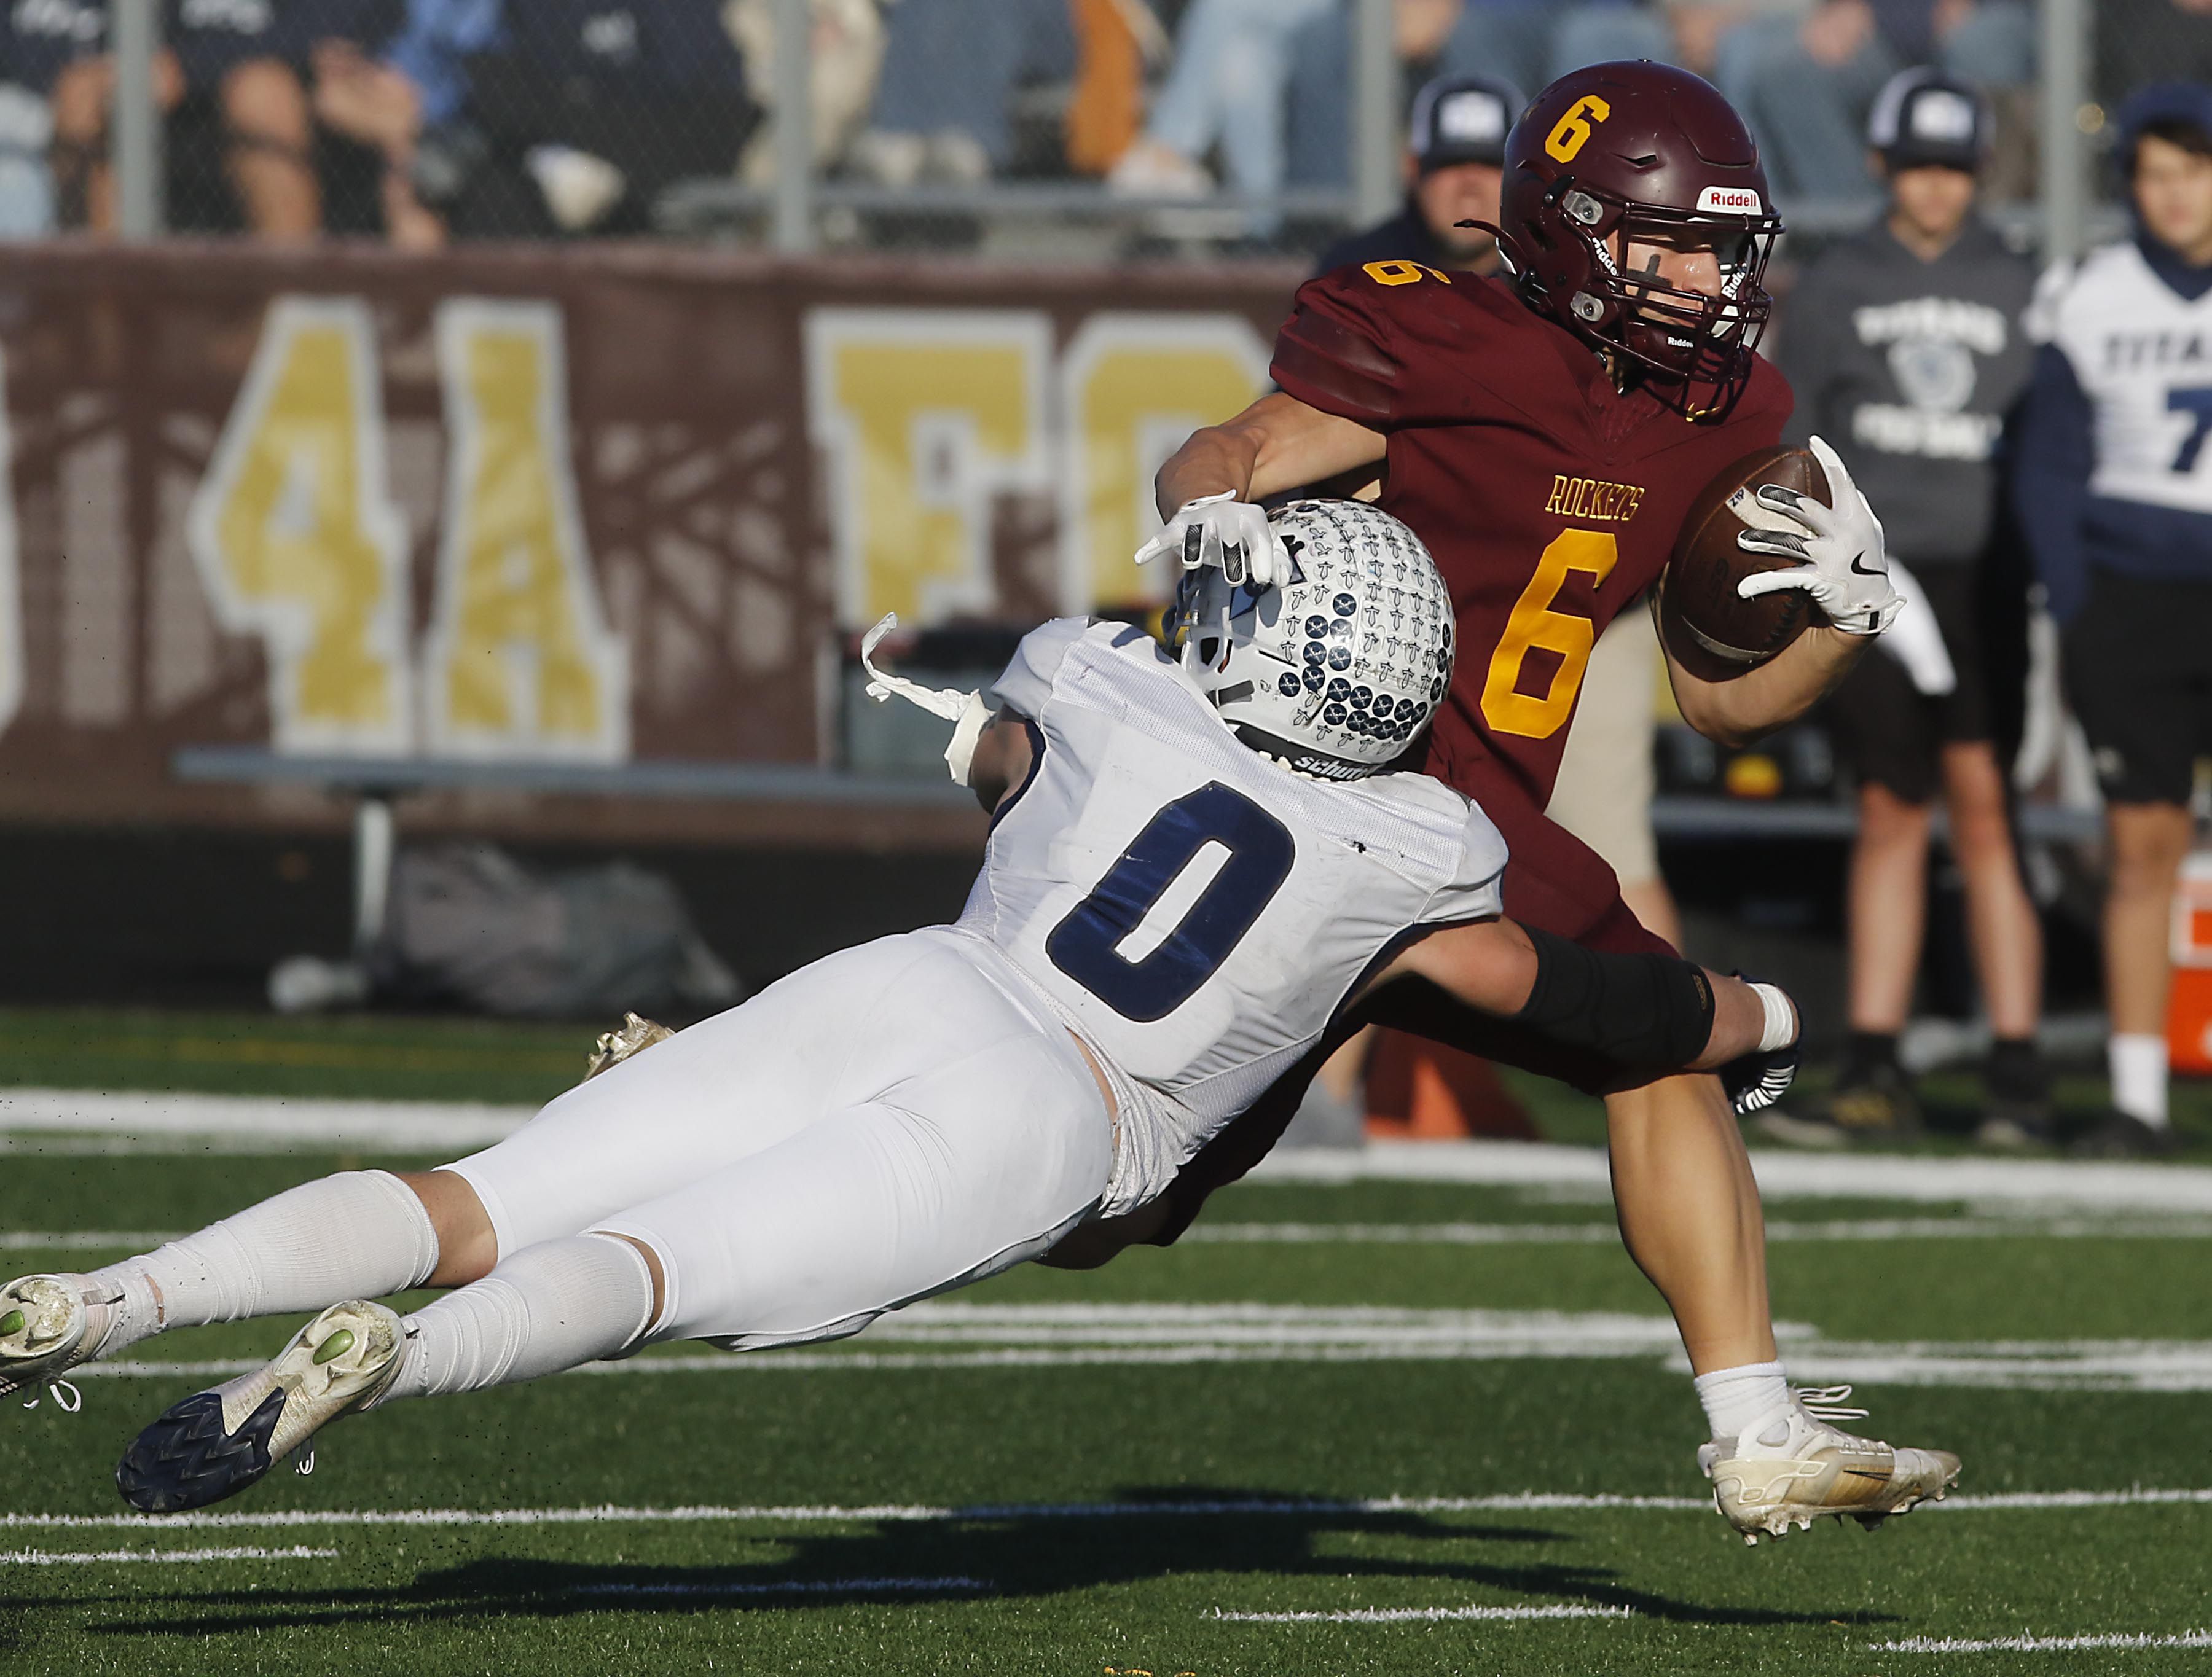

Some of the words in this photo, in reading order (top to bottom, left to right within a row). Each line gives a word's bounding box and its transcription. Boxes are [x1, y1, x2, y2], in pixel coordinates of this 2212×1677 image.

[1545, 94, 1611, 164] 6
[1711, 192, 1757, 207] Riddell
[1362, 259, 1452, 286] 6
[1592, 237, 1617, 276] idde
[2166, 387, 2212, 472] 7
[186, 294, 632, 760] 4A
[1545, 475, 1645, 521] ROCKETS
[1480, 527, 1618, 740] 6
[1045, 778, 1296, 1023] 0
